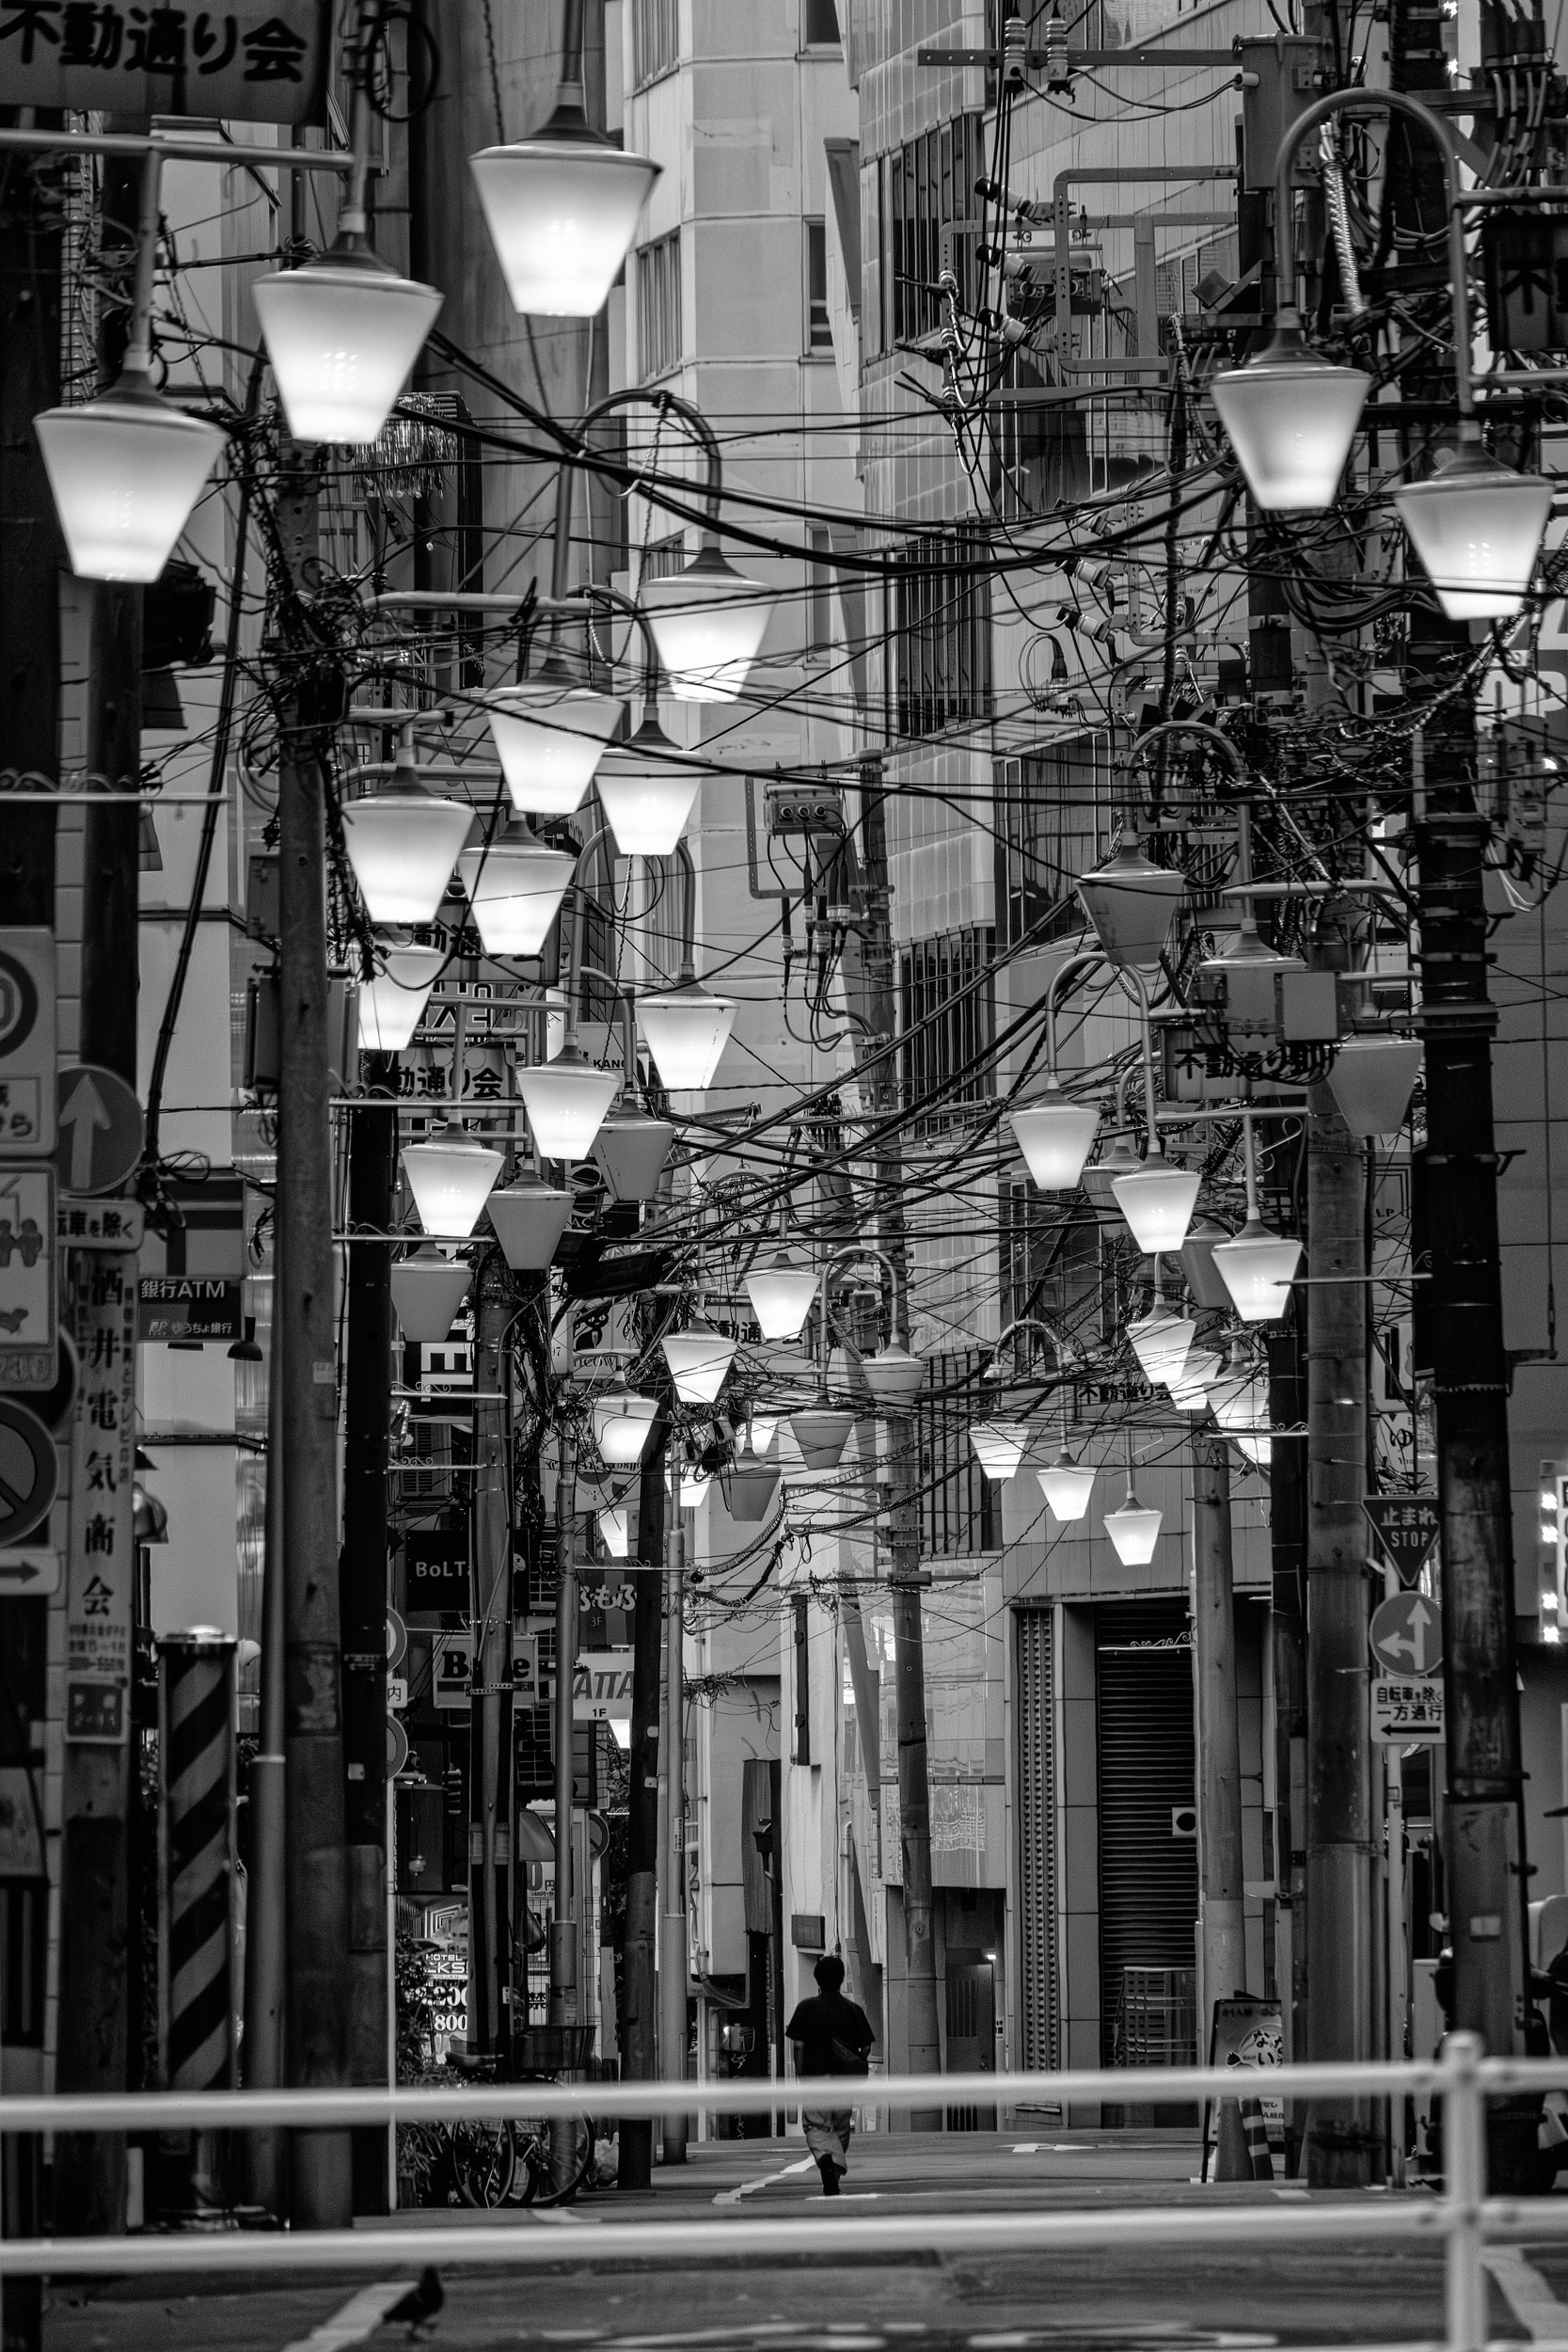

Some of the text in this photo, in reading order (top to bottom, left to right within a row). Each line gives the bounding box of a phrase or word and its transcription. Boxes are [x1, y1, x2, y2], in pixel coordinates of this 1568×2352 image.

[0, 1, 307, 83] 不動通り会
[141, 1280, 226, 1298] 銀行ATM
[1380, 1506, 1438, 1527] 止まれ
[1390, 1531, 1430, 1549] STOP
[592, 1708, 607, 1718] 1F
[1376, 1705, 1444, 1722] 一方通行
[425, 1953, 463, 1962] HOTEL
